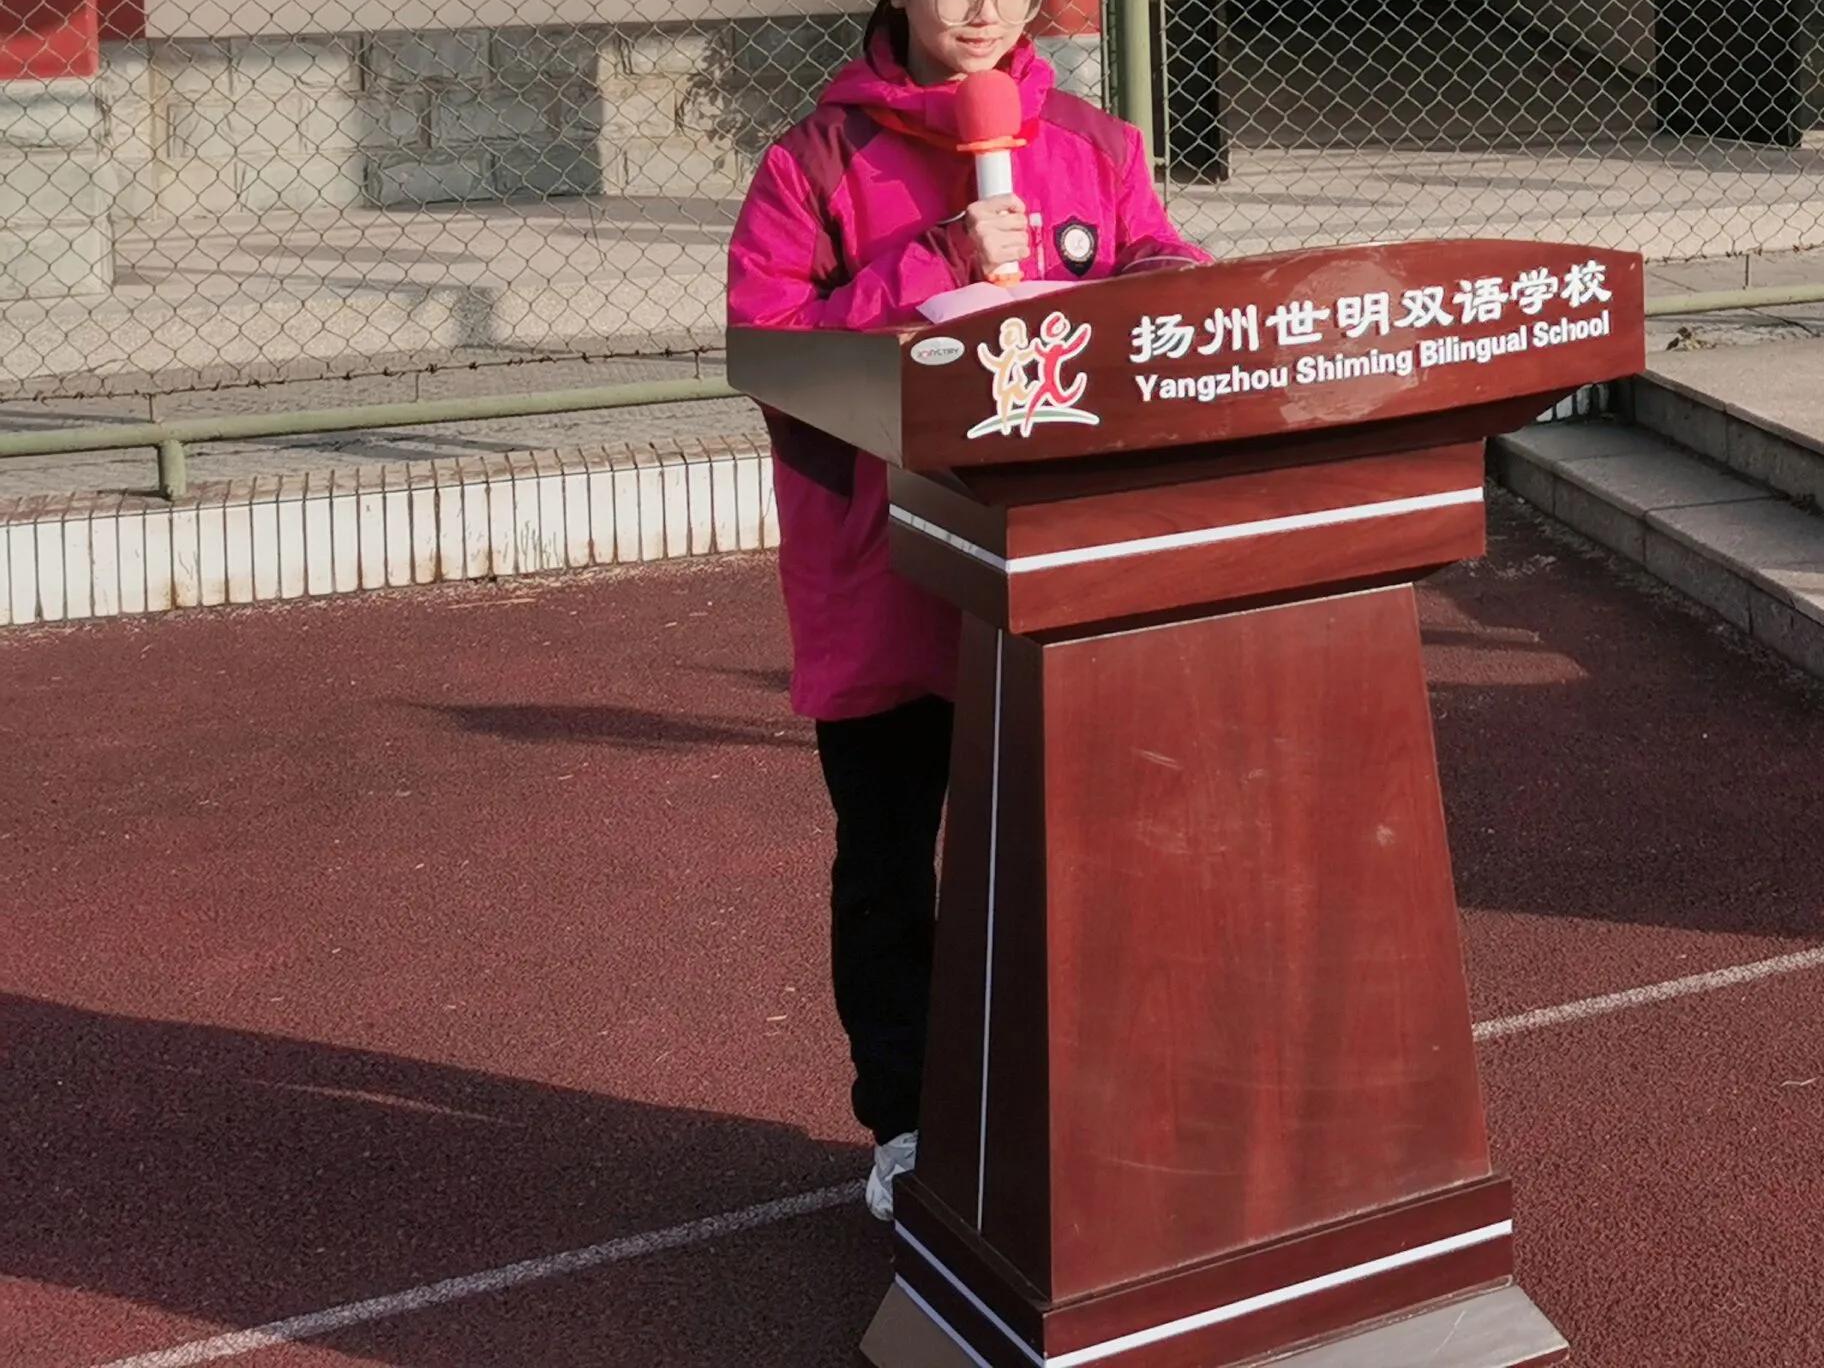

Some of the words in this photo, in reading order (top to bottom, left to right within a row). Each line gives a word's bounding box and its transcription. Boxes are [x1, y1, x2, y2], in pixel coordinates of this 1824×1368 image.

[1129, 259, 1613, 364] 扬州世明双语学校
[1134, 364, 1289, 402] Yangzhou
[1296, 348, 1414, 384] Shiming
[1418, 324, 1528, 368] Bilingual
[1532, 309, 1610, 348] School
